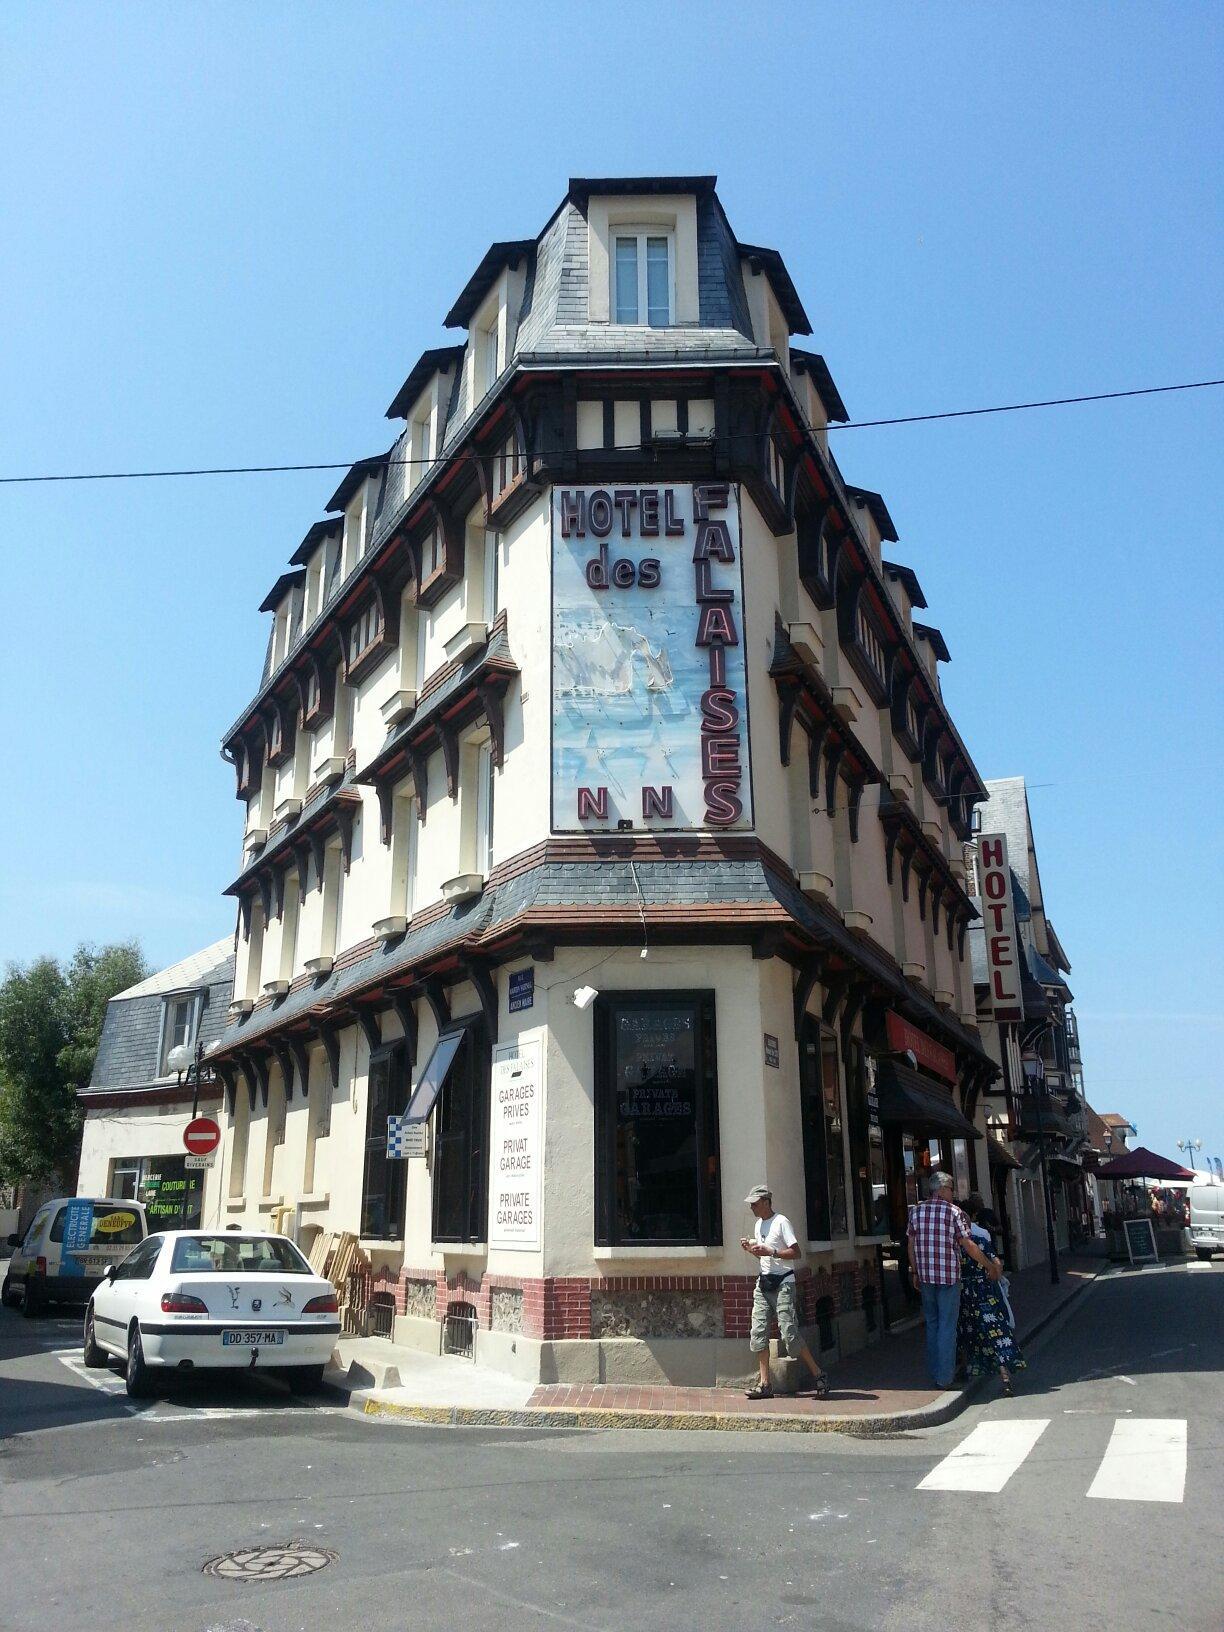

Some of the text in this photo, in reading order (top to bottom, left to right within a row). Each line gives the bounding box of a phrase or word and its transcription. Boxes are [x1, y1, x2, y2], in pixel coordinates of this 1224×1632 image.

[561, 488, 685, 537] HOTEL
[585, 543, 662, 590] des
[692, 482, 743, 825] FALAISES
[577, 785, 674, 820] N N
[981, 838, 1016, 1000] HOTEL
[499, 1084, 535, 1103] GARAGES
[503, 1103, 529, 1118] PRIVES
[503, 1138, 528, 1153] PRIVAT
[500, 1156, 531, 1170] GARAGE
[149, 1205, 173, 1214] ARTISAN
[500, 1193, 530, 1207] PRIVATE
[496, 1210, 533, 1224] GARAGES
[77, 1206, 90, 1249] GENERALE
